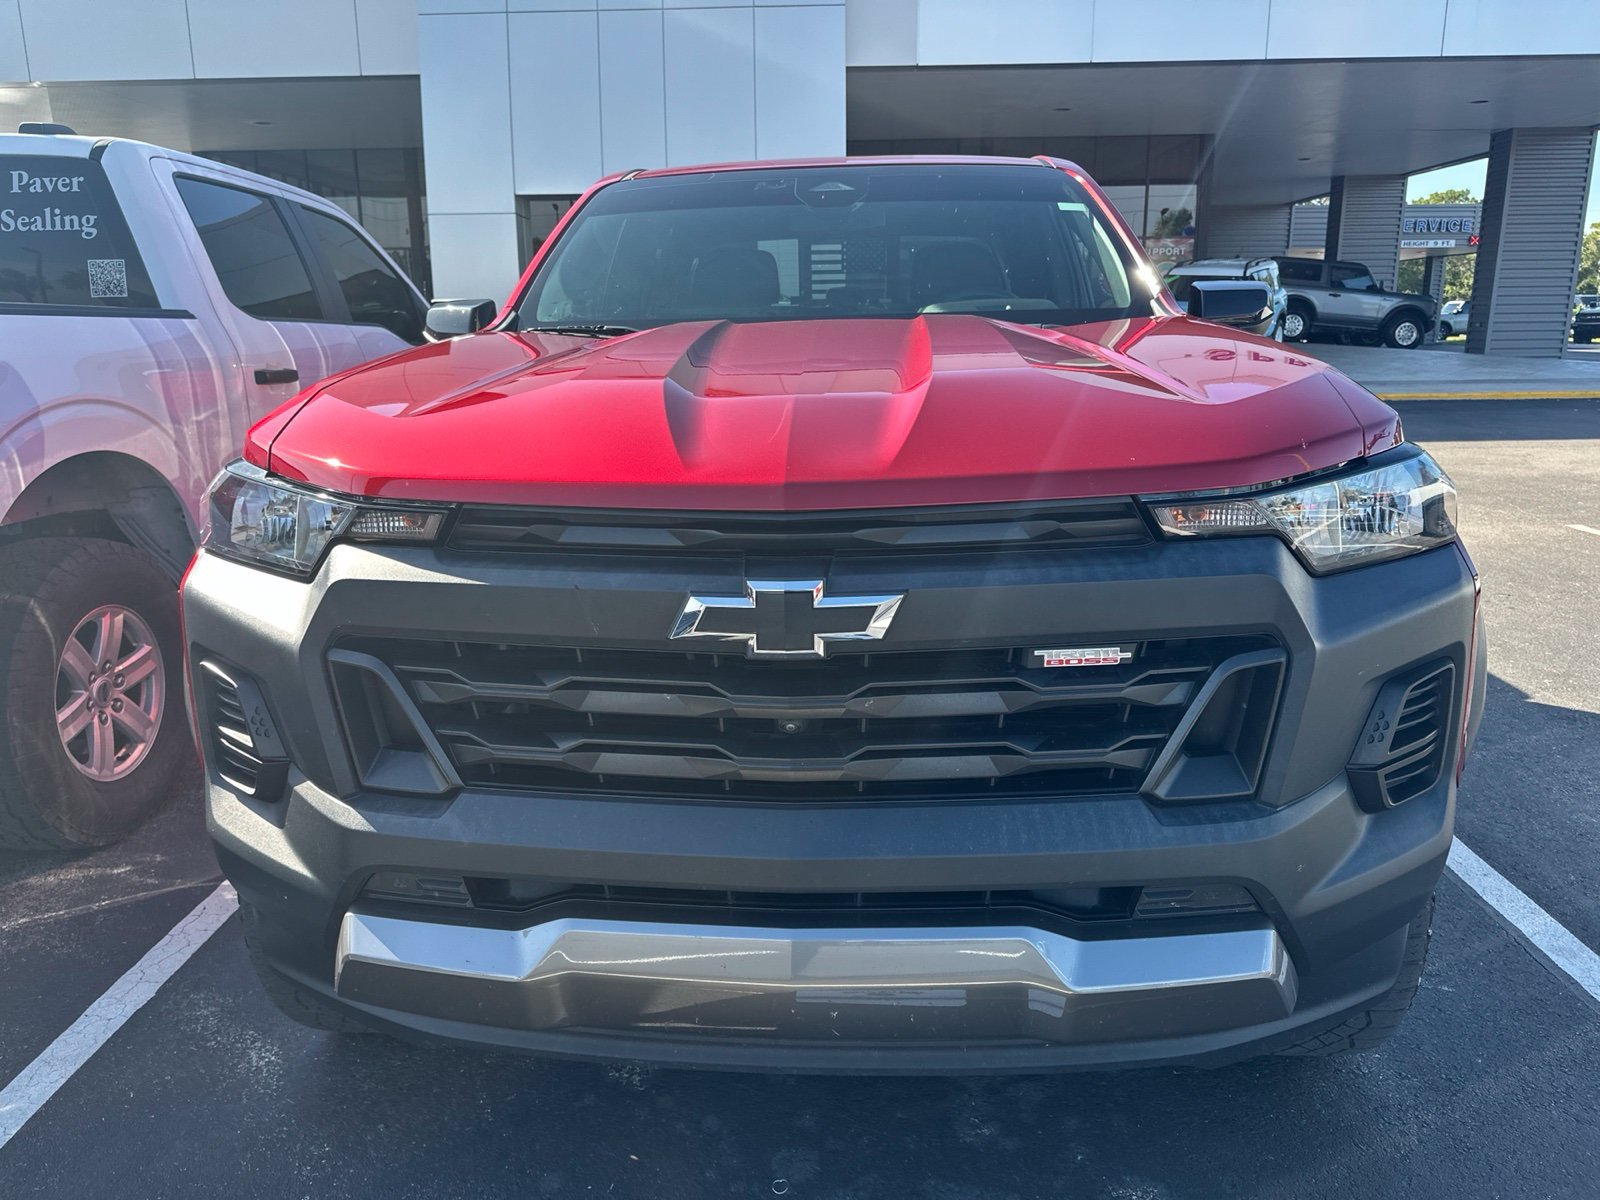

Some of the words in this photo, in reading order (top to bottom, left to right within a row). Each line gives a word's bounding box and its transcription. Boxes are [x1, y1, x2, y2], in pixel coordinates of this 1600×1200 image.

[9, 170, 85, 193] Paver
[0, 207, 98, 240] Sealing
[1403, 218, 1474, 233] ERVICE
[1147, 247, 1186, 256] PPORT
[1034, 648, 1132, 659] TRAIL
[1045, 656, 1120, 667] BOSS
